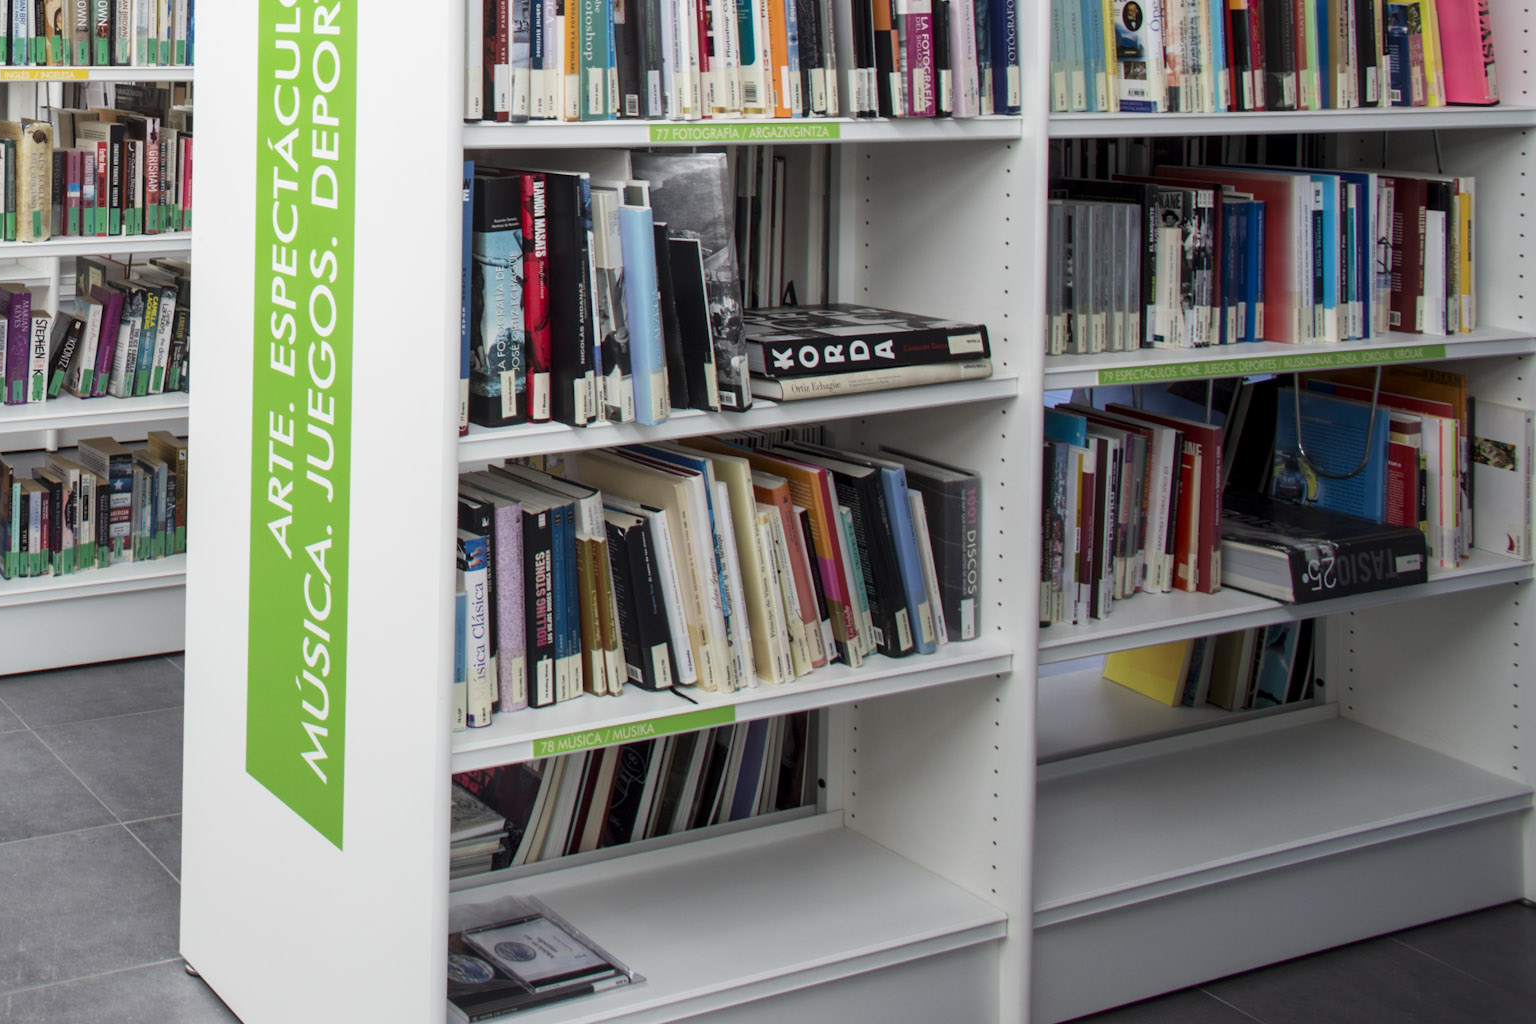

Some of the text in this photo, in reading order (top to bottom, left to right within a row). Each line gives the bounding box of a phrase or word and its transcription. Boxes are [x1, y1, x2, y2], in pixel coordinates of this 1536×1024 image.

[724, 14, 732, 58] Photoshop
[40, 71, 75, 79] INGELESA
[920, 16, 932, 108] LA FOTOGRAFÍA
[655, 124, 830, 140] 77 FOTOGRAFÍA ARGAZKIGINTZA
[148, 150, 158, 192] GRISHAM
[533, 180, 546, 216] RAMÓN
[1158, 192, 1182, 210] KANE
[533, 218, 546, 257] MASATS
[1149, 241, 1154, 252] EL
[496, 266, 504, 281] DE
[14, 304, 22, 329] KEYES
[21, 300, 30, 332] MARIAN
[149, 296, 159, 327] CAMILLA
[494, 283, 506, 357] FOTOGRAFÍA
[508, 250, 520, 372] JOSÉ ORTIZ ECHAGÜE
[35, 319, 47, 359] STEPHEN
[58, 339, 77, 368] KOONTZ
[771, 339, 897, 370] KORDA
[304, 236, 339, 502] JUEGOS.
[791, 379, 841, 392] Ortiz Echagüe
[1103, 371, 1113, 382] 79
[1238, 358, 1276, 373] DEPORTES
[266, 399, 296, 559] ARTE.
[717, 533, 727, 559] tiempo
[967, 487, 977, 595] 1001 DISCOS
[1338, 548, 1395, 585] TASIO
[471, 582, 486, 638] Clásica
[535, 552, 548, 647] ROLLING STONES
[295, 522, 334, 784] MÚSICA.
[540, 723, 655, 753] 78 MÚSICA MUSIKA
